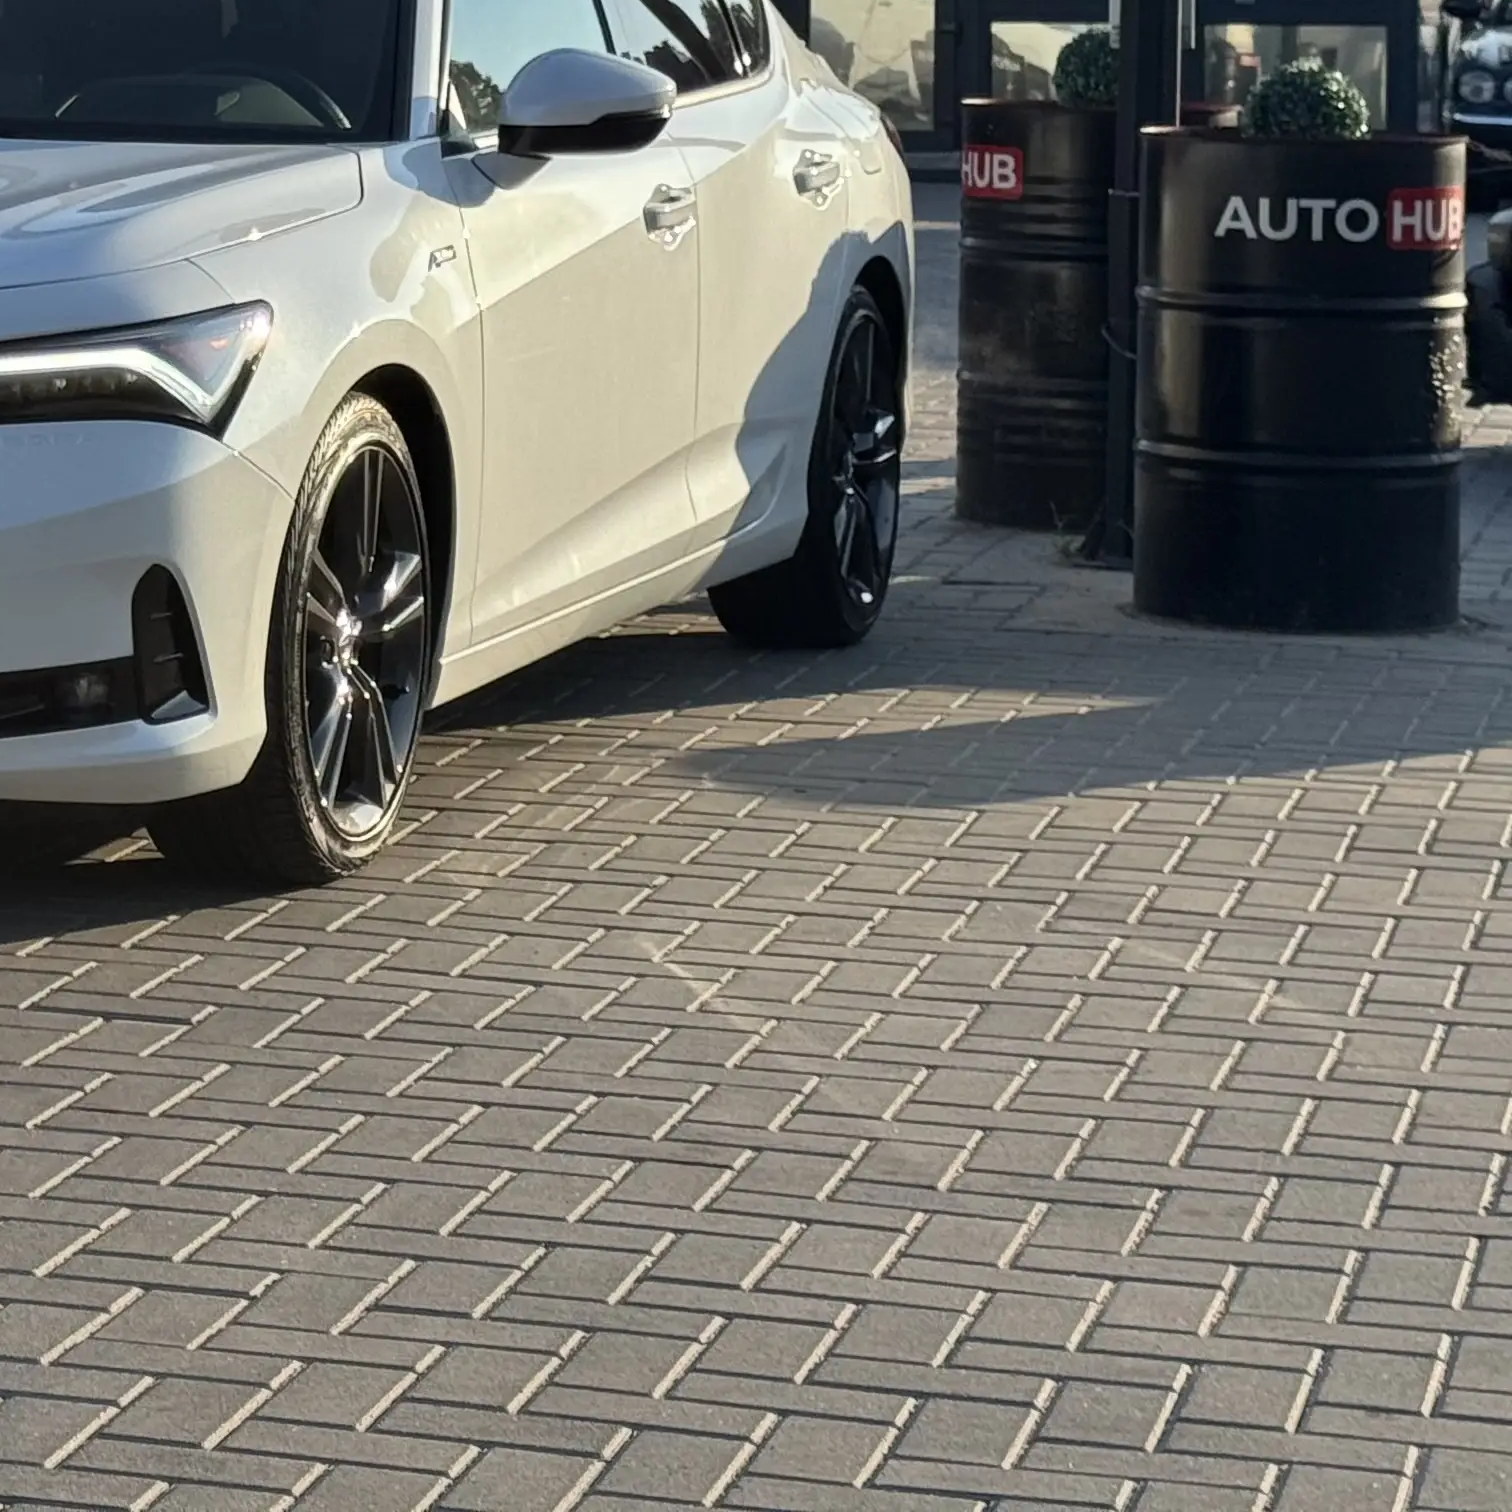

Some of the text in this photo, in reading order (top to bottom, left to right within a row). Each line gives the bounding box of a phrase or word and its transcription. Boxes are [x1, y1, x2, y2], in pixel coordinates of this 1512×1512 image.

[961, 150, 1017, 189] HUB
[1214, 195, 1463, 243] AUTO HUB
